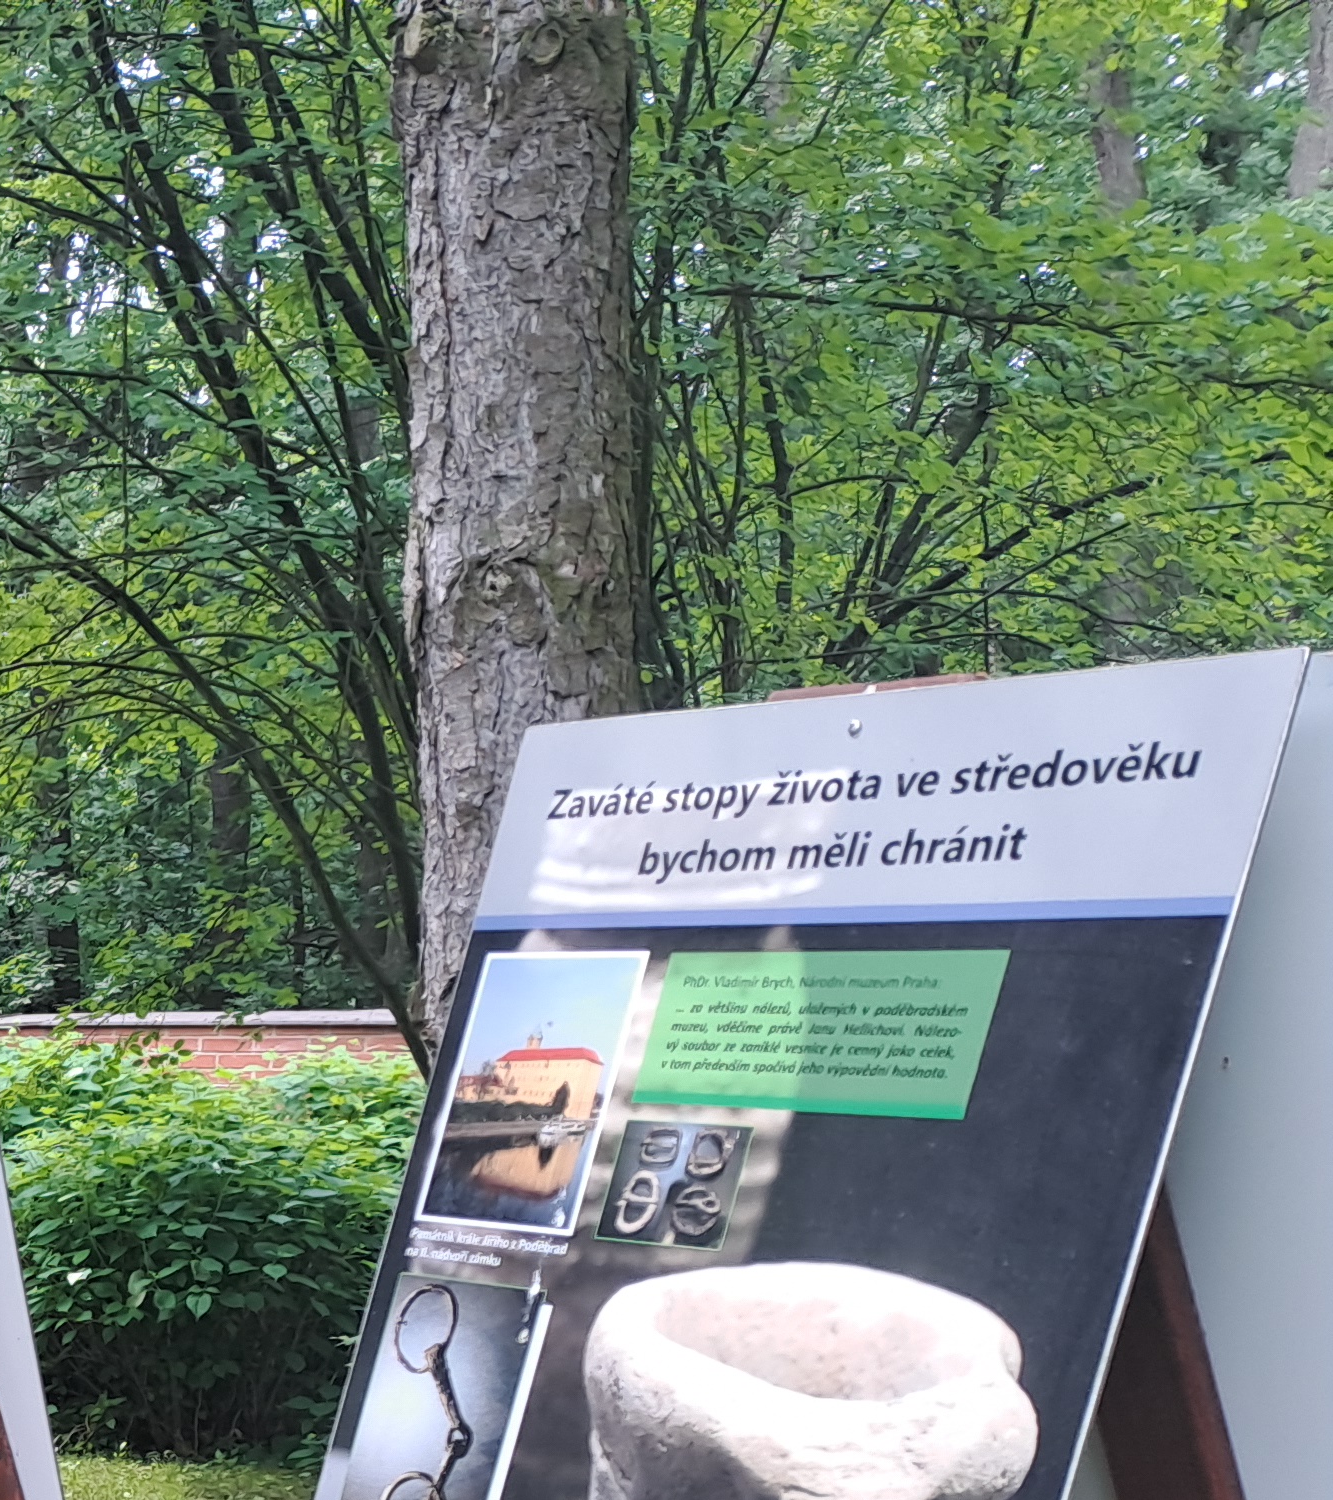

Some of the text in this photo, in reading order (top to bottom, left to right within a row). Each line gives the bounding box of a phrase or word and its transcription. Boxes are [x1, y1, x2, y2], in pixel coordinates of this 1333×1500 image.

[547, 741, 1202, 820] Zaváté stopy života ve středověku
[638, 823, 1028, 884] bychom měli chránit
[683, 975, 710, 988] PhDr.
[708, 1001, 749, 1014] většinu
[752, 1001, 792, 1017] nálezů,
[862, 1006, 871, 1016] v
[874, 1002, 969, 1018] poděbradském
[671, 1022, 709, 1034] muzeu,
[767, 1021, 803, 1036] právě
[666, 1039, 955, 1060] vý soubor ze zaniklé vesnice je cenný jako celek,
[661, 1058, 948, 1079] v tom především spočívá jeho výpovědní hodnota.
[517, 1237, 569, 1256] Poděbrad
